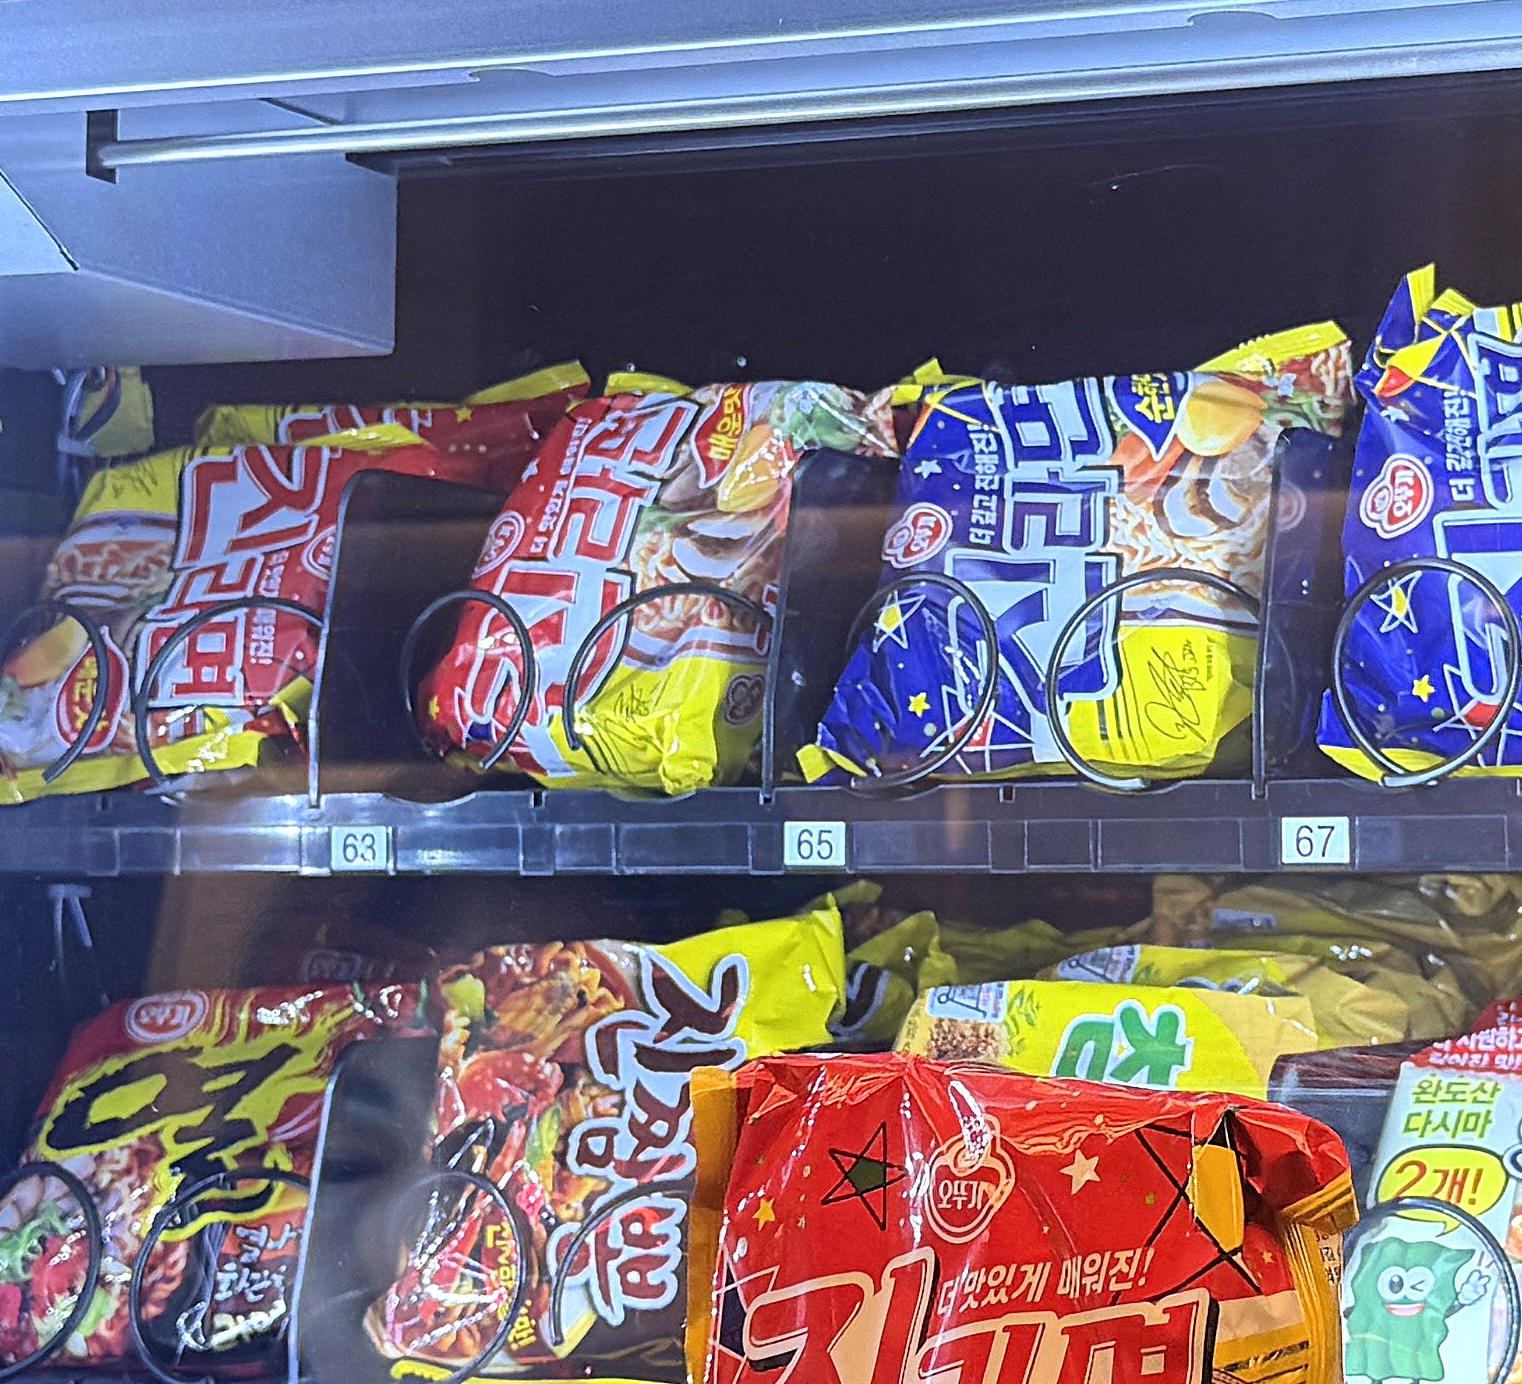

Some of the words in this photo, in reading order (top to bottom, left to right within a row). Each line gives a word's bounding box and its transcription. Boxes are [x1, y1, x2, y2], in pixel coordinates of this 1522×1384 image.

[707, 387, 745, 461] 매운맛
[968, 423, 999, 490] 진해진!
[1452, 477, 1474, 501] 더
[970, 494, 997, 527] 깊고
[946, 377, 1122, 718] 진라면
[969, 528, 995, 546] 더
[141, 445, 327, 702] 진라면
[467, 396, 700, 730] 진라면
[342, 833, 378, 861] 63
[796, 829, 834, 860] 65
[1294, 825, 1336, 860] 67
[1411, 1077, 1500, 1107] 완도산
[552, 948, 747, 1322] 진짬뽕
[1403, 1108, 1493, 1140] 다시마
[936, 1180, 994, 1212] 오뚜기
[1394, 1159, 1484, 1207] 2개!
[939, 1279, 960, 1316] 더
[961, 1260, 1052, 1310] 맛있게
[1057, 1246, 1154, 1299] 매워진!
